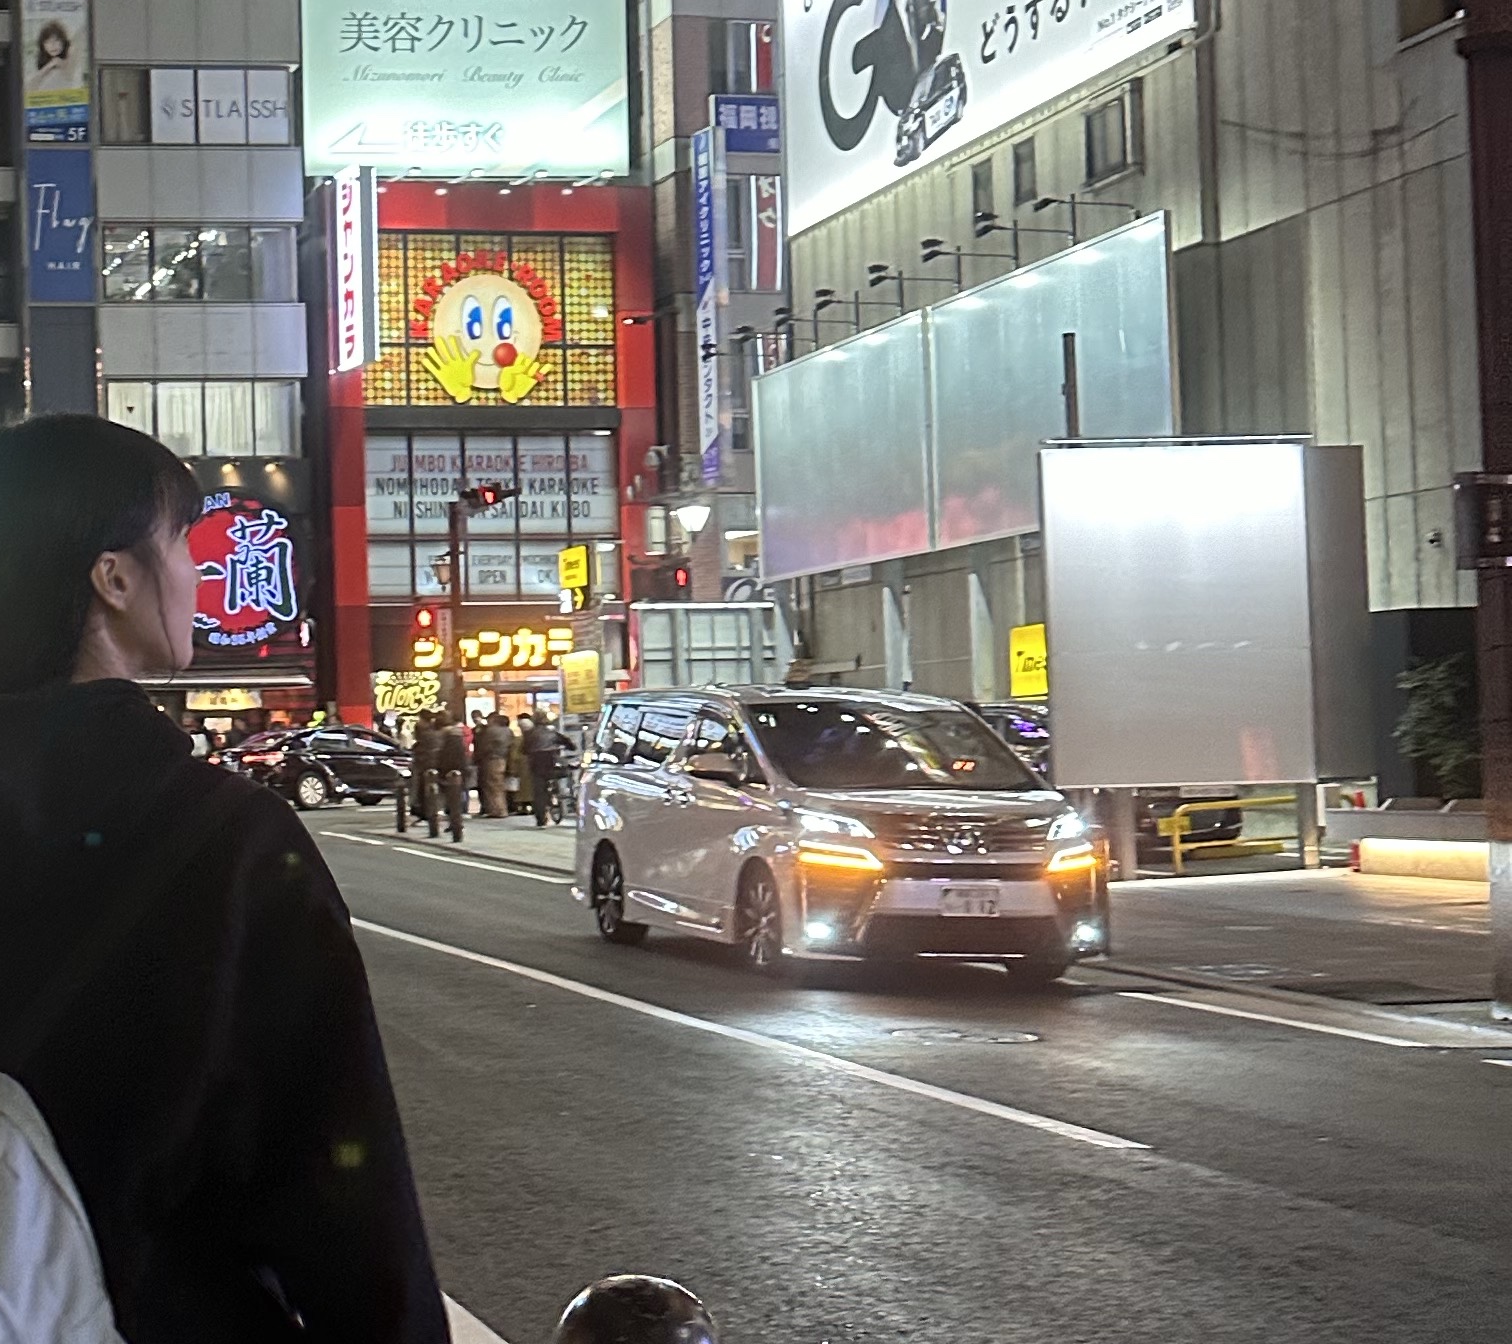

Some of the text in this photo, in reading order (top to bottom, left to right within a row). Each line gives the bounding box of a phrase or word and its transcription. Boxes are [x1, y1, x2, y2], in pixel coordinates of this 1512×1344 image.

[339, 11, 589, 55] 美容クリニック
[341, 66, 585, 90] Mizunomori Beauty Clinic
[67, 128, 87, 142] 5F
